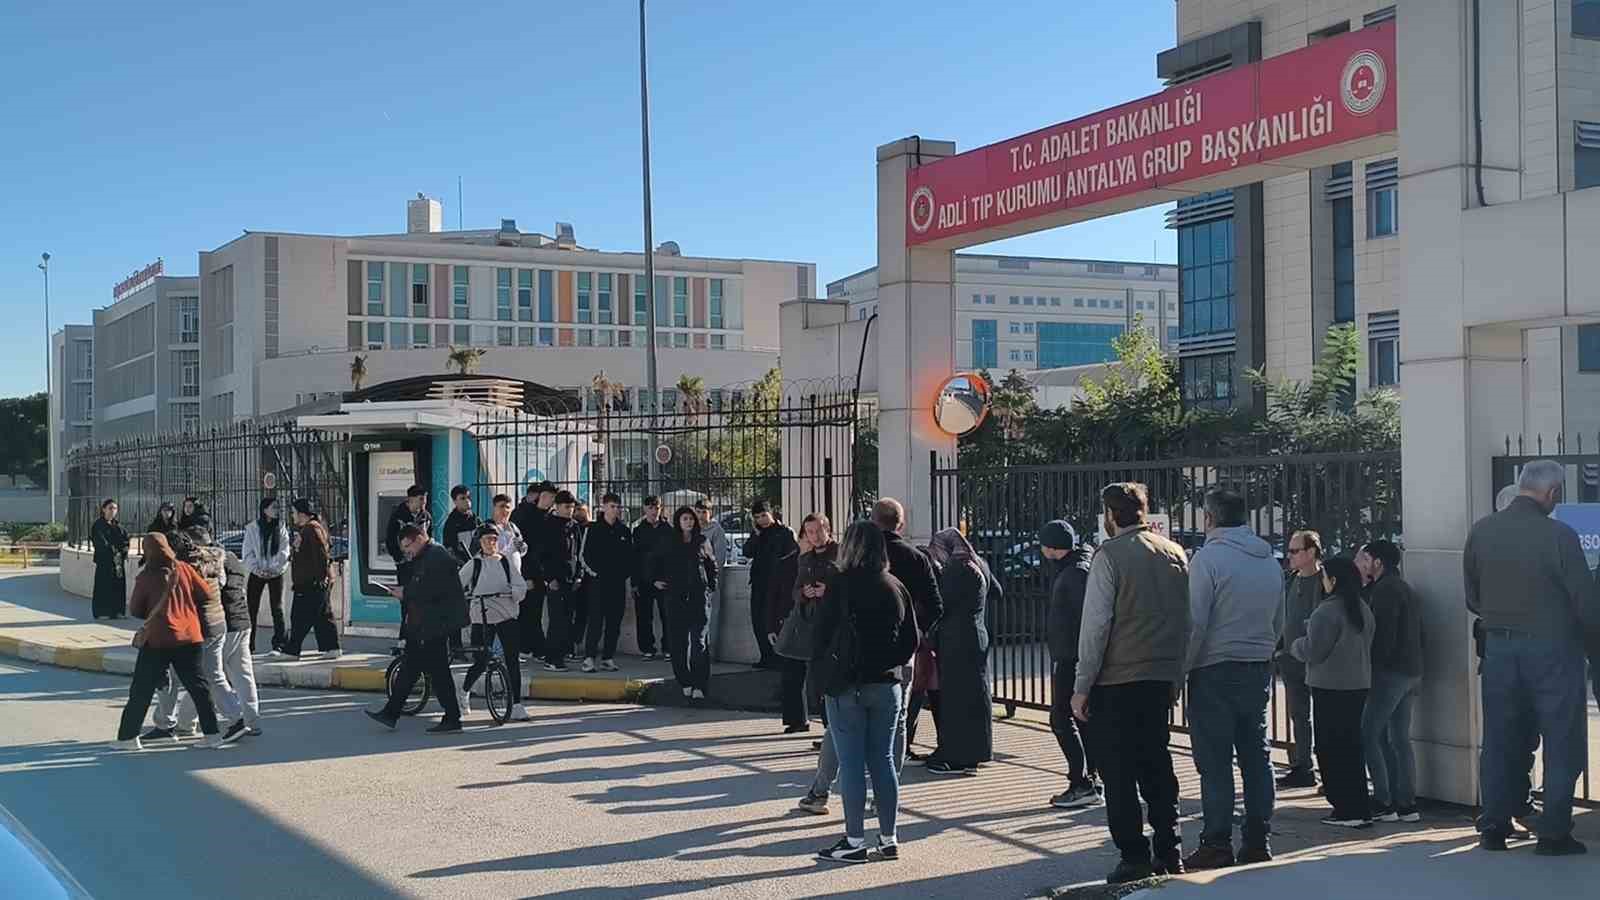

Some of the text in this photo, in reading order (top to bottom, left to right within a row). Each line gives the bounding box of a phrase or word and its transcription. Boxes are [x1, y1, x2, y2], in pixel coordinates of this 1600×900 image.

[938, 194, 967, 229] ADLİ
[971, 193, 994, 221] TIP
[997, 174, 1061, 216] KURUMU
[1066, 155, 1137, 198] ANTALYA
[1142, 140, 1192, 180] GRUP
[1201, 95, 1333, 166] BAŞKANLIĞI
[1009, 88, 1202, 173] T.C. ADALET BAKANLIĞI
